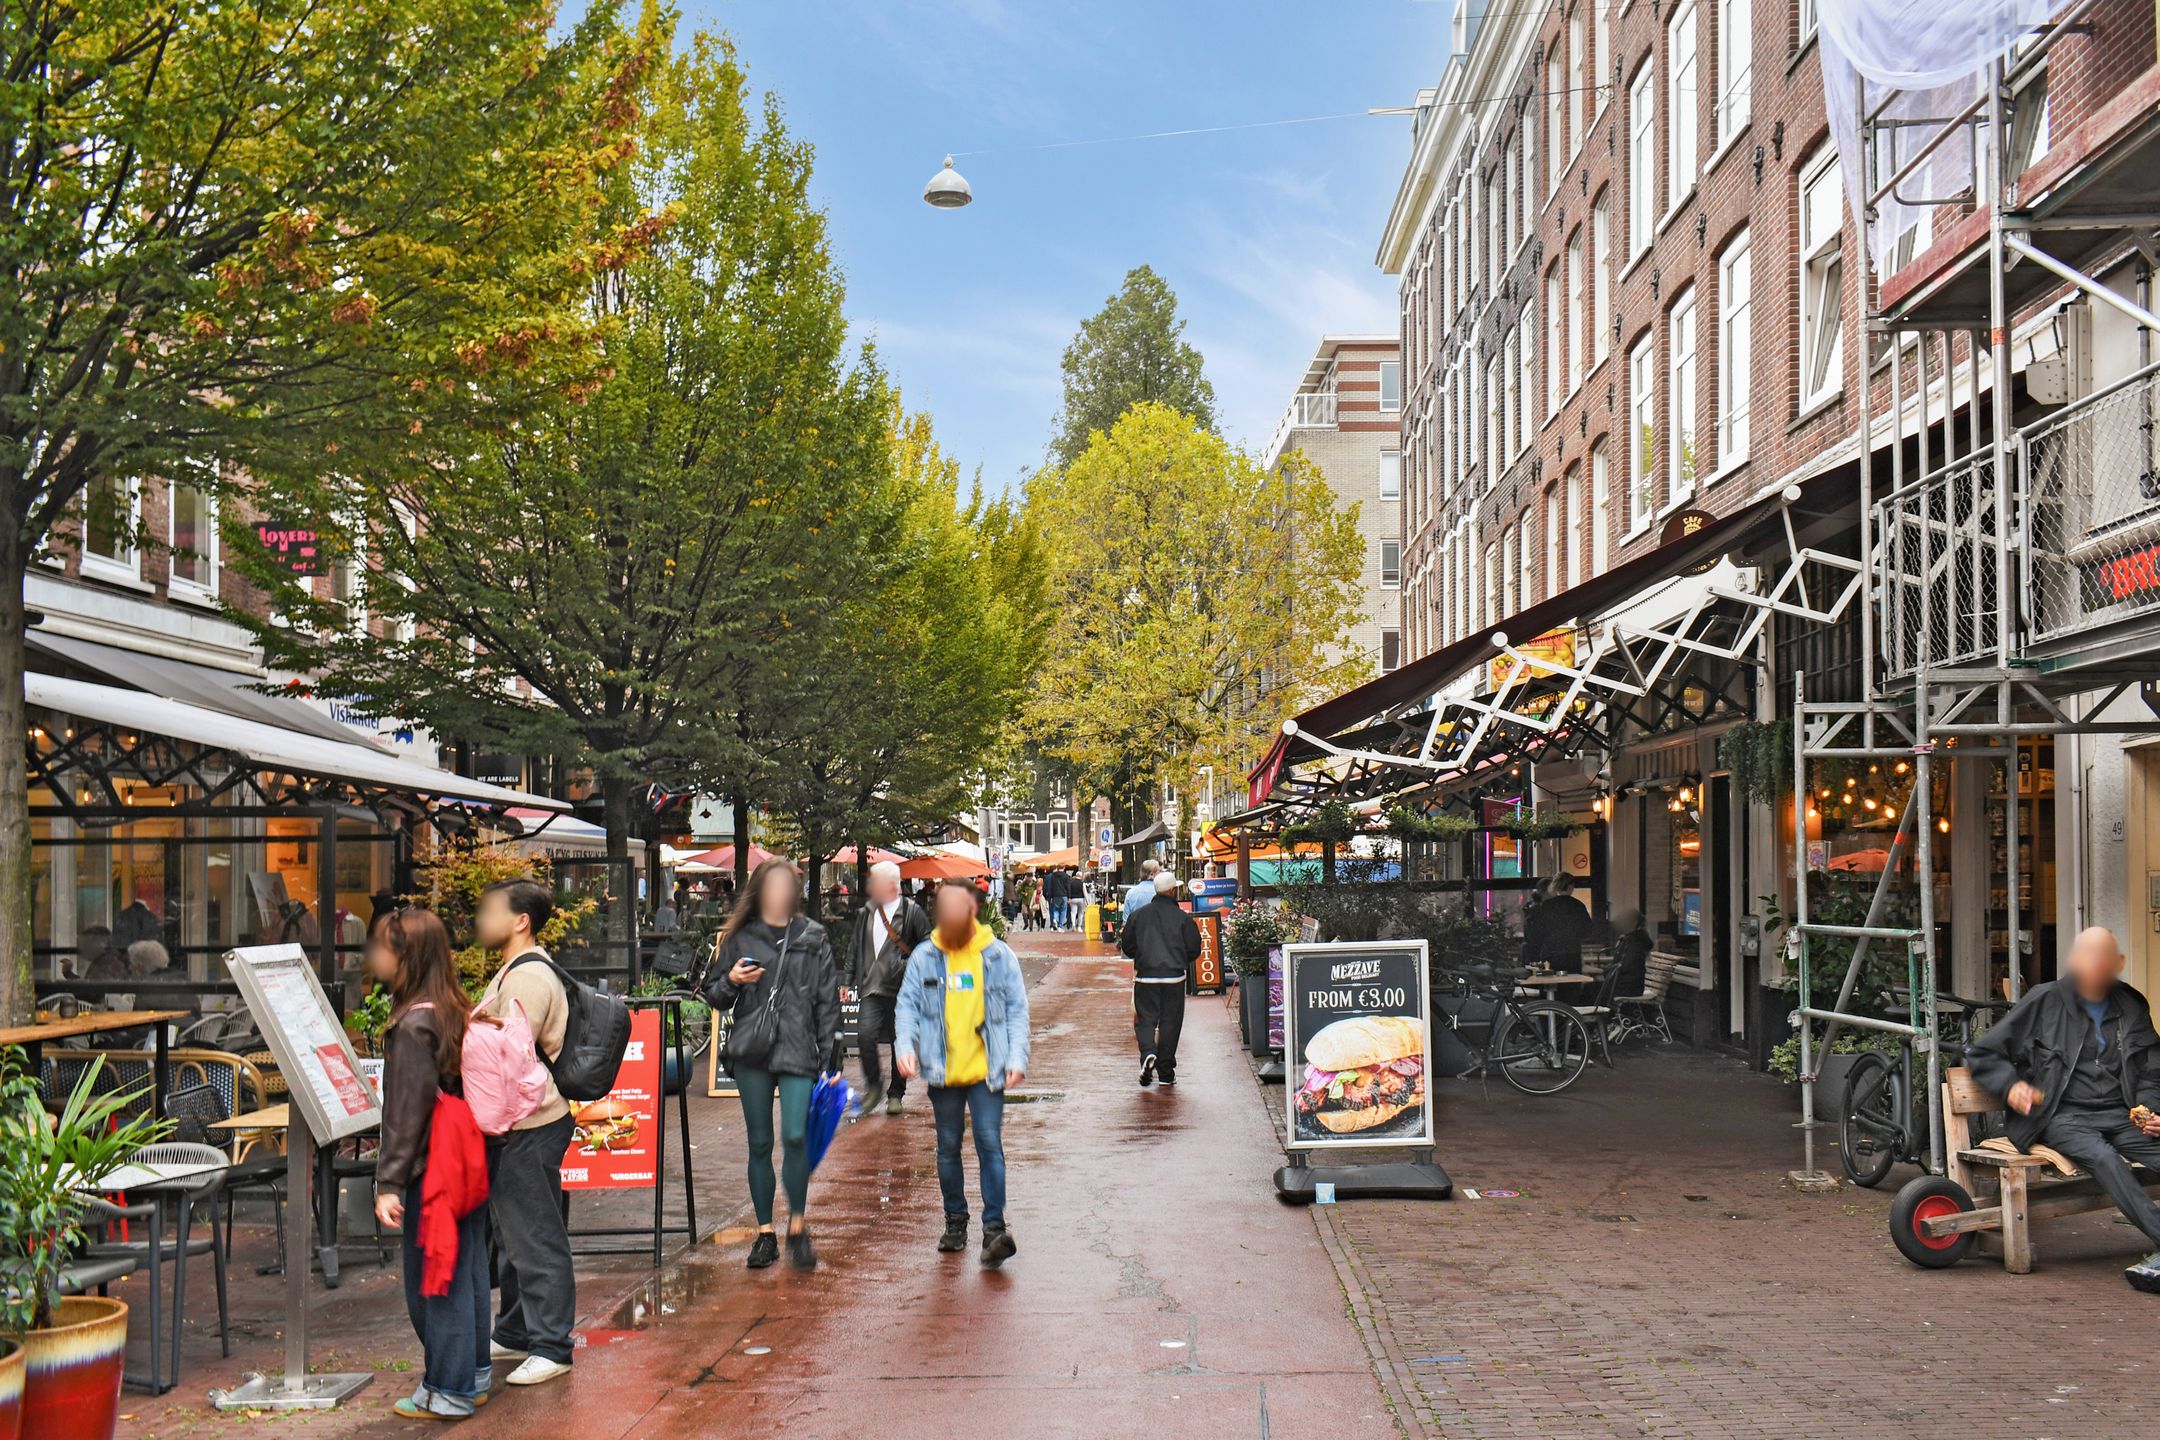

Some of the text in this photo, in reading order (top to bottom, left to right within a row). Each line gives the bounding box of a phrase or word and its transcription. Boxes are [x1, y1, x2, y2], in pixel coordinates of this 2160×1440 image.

[2112, 821, 2122, 835] 49
[1199, 917, 1214, 982] TATTOO
[1331, 960, 1381, 981] MEZZAVE
[1309, 987, 1405, 1008] FROM €3,00
